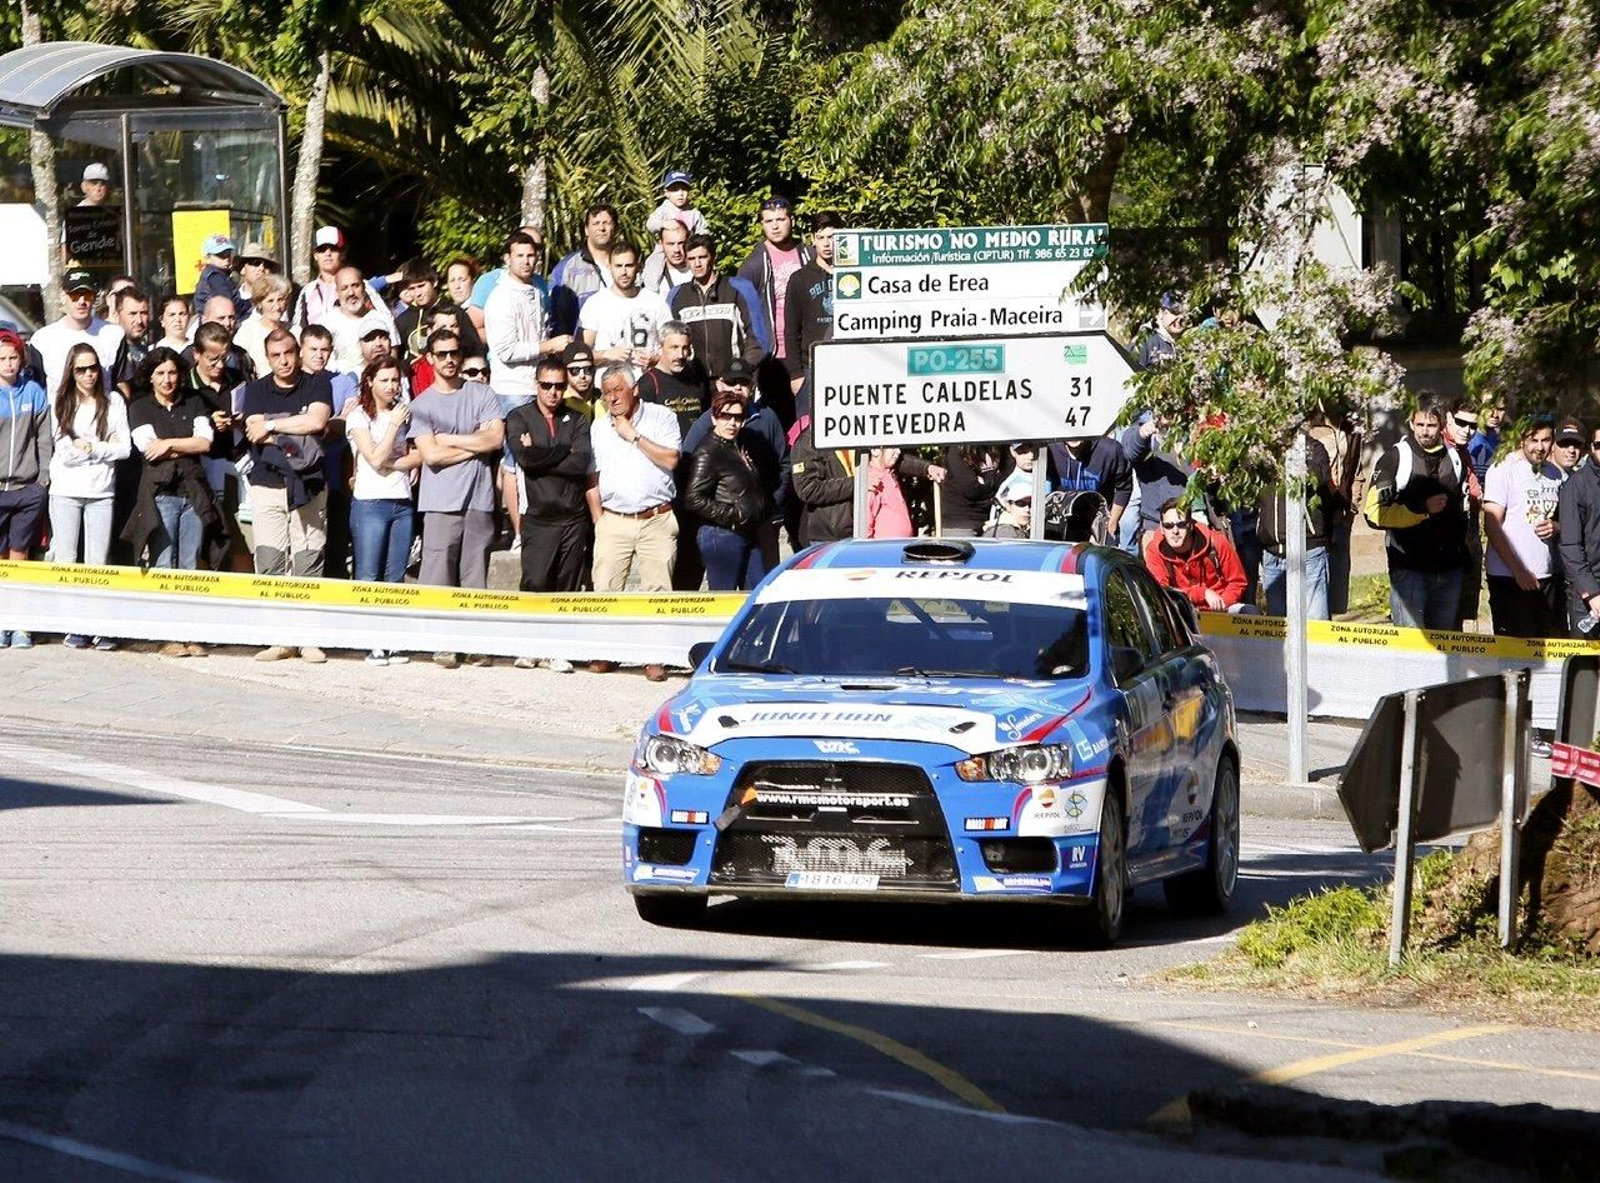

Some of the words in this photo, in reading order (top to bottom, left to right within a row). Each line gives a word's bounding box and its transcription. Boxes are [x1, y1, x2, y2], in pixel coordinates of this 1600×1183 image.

[861, 233, 943, 251] TURISMO
[950, 232, 978, 250] NO
[985, 230, 1041, 248] MEDIO
[1035, 248, 1052, 259] 986
[1055, 248, 1067, 258] 65
[1069, 247, 1081, 258] 23
[1083, 247, 1095, 258] 82
[868, 275, 911, 294] Casa
[919, 274, 941, 292] de
[949, 274, 989, 292] Erea
[838, 310, 921, 335] Camping
[914, 348, 998, 371] PO-255
[824, 383, 907, 407] PUENTE
[922, 379, 1032, 403] CALDELAS
[1070, 377, 1092, 397] 31
[824, 411, 966, 437] PONTEVEDRA
[1065, 406, 1091, 427] 47
[74, 576, 110, 585] PUBLICO
[895, 570, 1016, 584] REPSOL
[174, 584, 210, 592] PUBLICO
[275, 591, 310, 599] PUBLICO
[375, 597, 409, 605] PUBLICO
[1254, 619, 1287, 627] AUTORIZ
[1352, 637, 1388, 645] PUBLICO
[1450, 645, 1486, 653] PUBLICO
[756, 794, 909, 808] www.rmcmotorsport.es
[1072, 846, 1086, 862] RV
